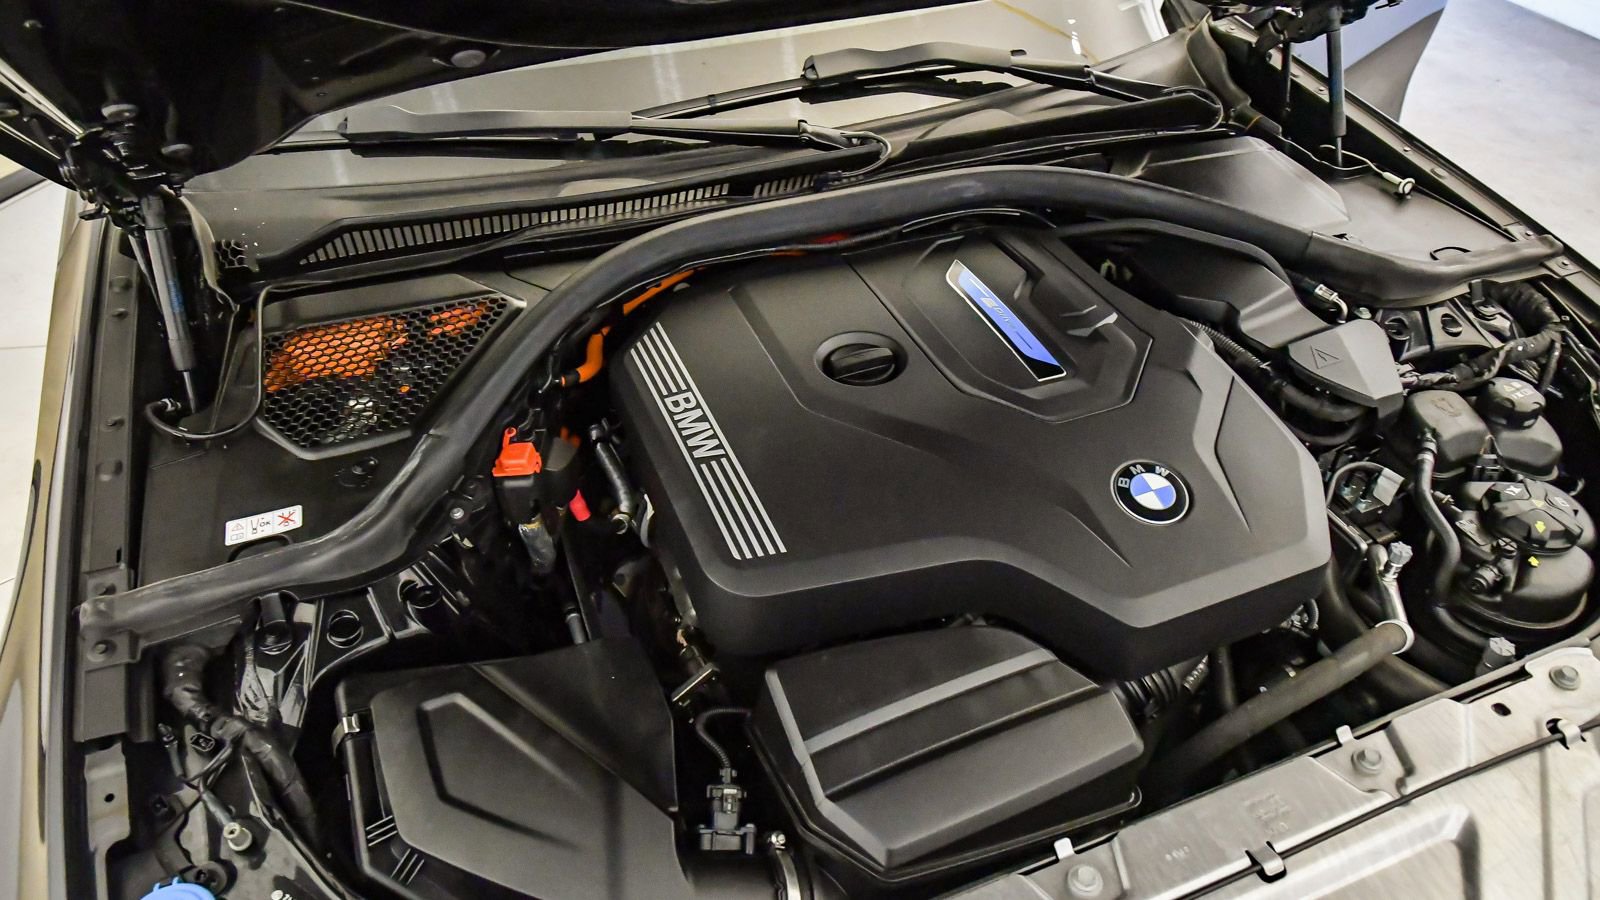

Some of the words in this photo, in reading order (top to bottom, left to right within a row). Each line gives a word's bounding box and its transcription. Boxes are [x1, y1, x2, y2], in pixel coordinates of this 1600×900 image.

[663, 391, 726, 460] BMW
[1117, 464, 1170, 489] BMW
[259, 520, 271, 528] OK
